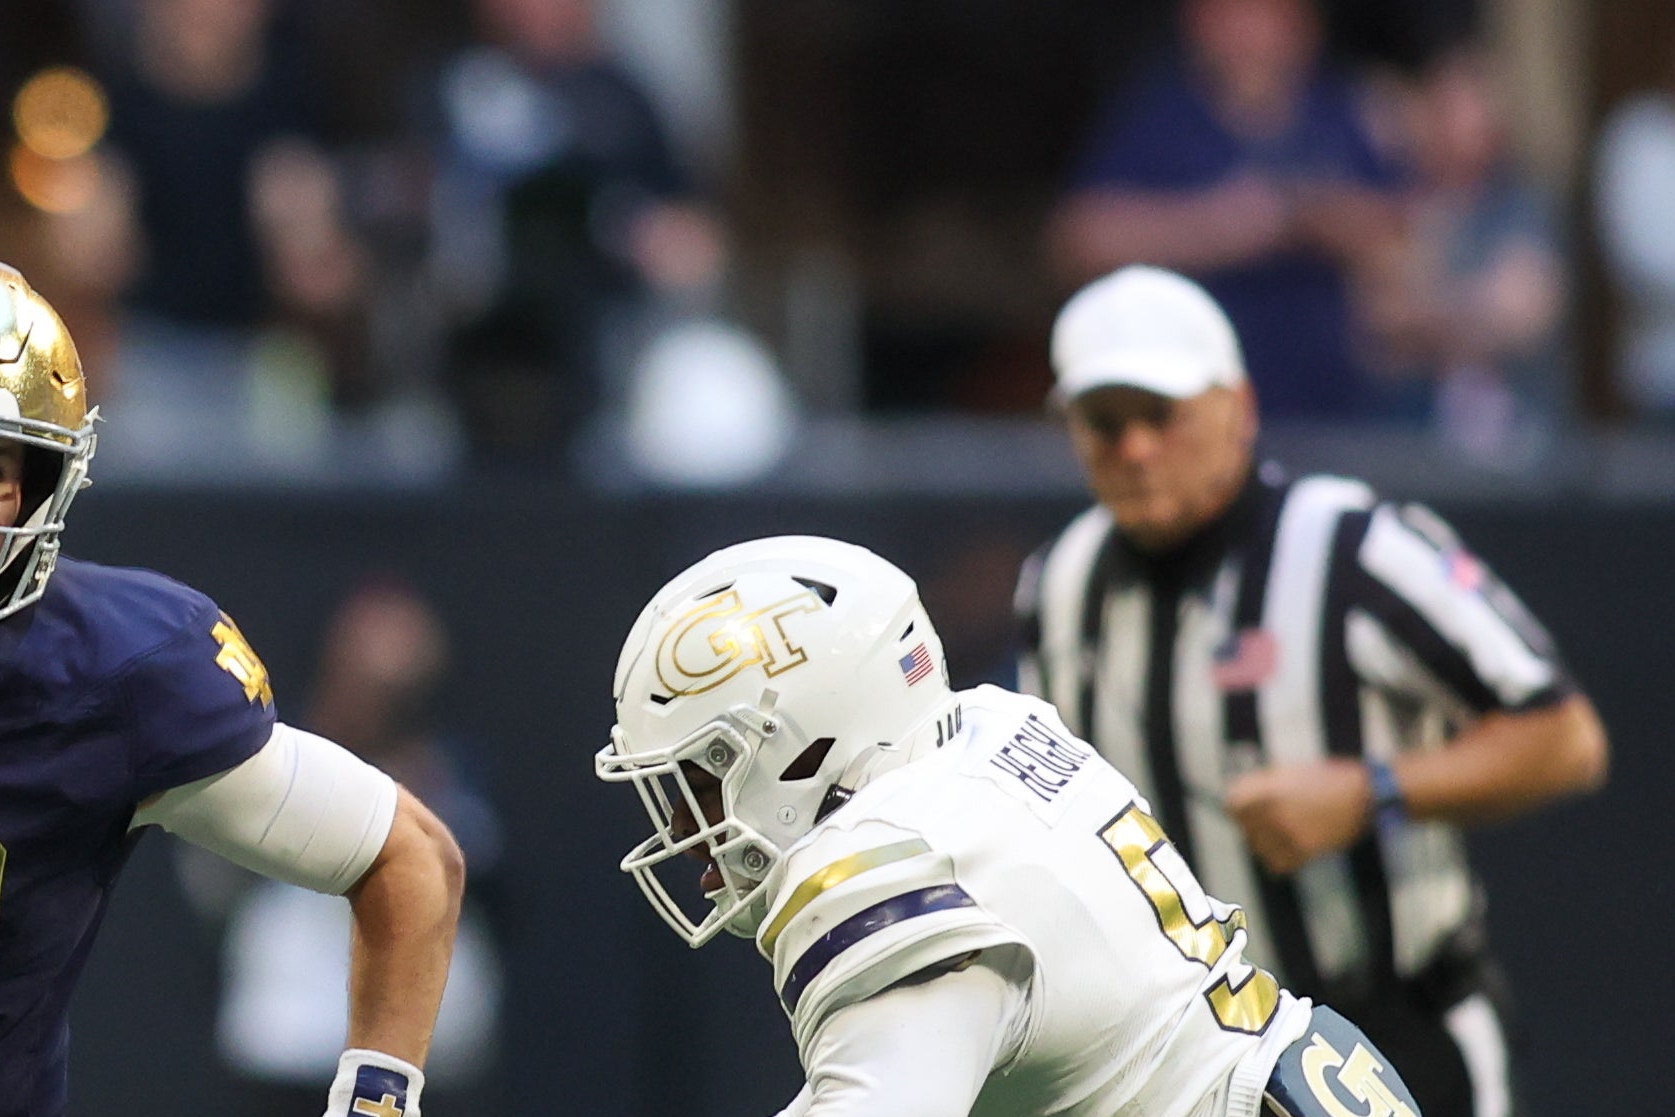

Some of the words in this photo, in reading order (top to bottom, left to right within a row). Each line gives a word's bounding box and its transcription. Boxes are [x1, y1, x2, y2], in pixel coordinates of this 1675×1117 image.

[656, 589, 823, 697] GT
[989, 712, 1091, 802] HEIGHT
[1095, 799, 1283, 1037] 5
